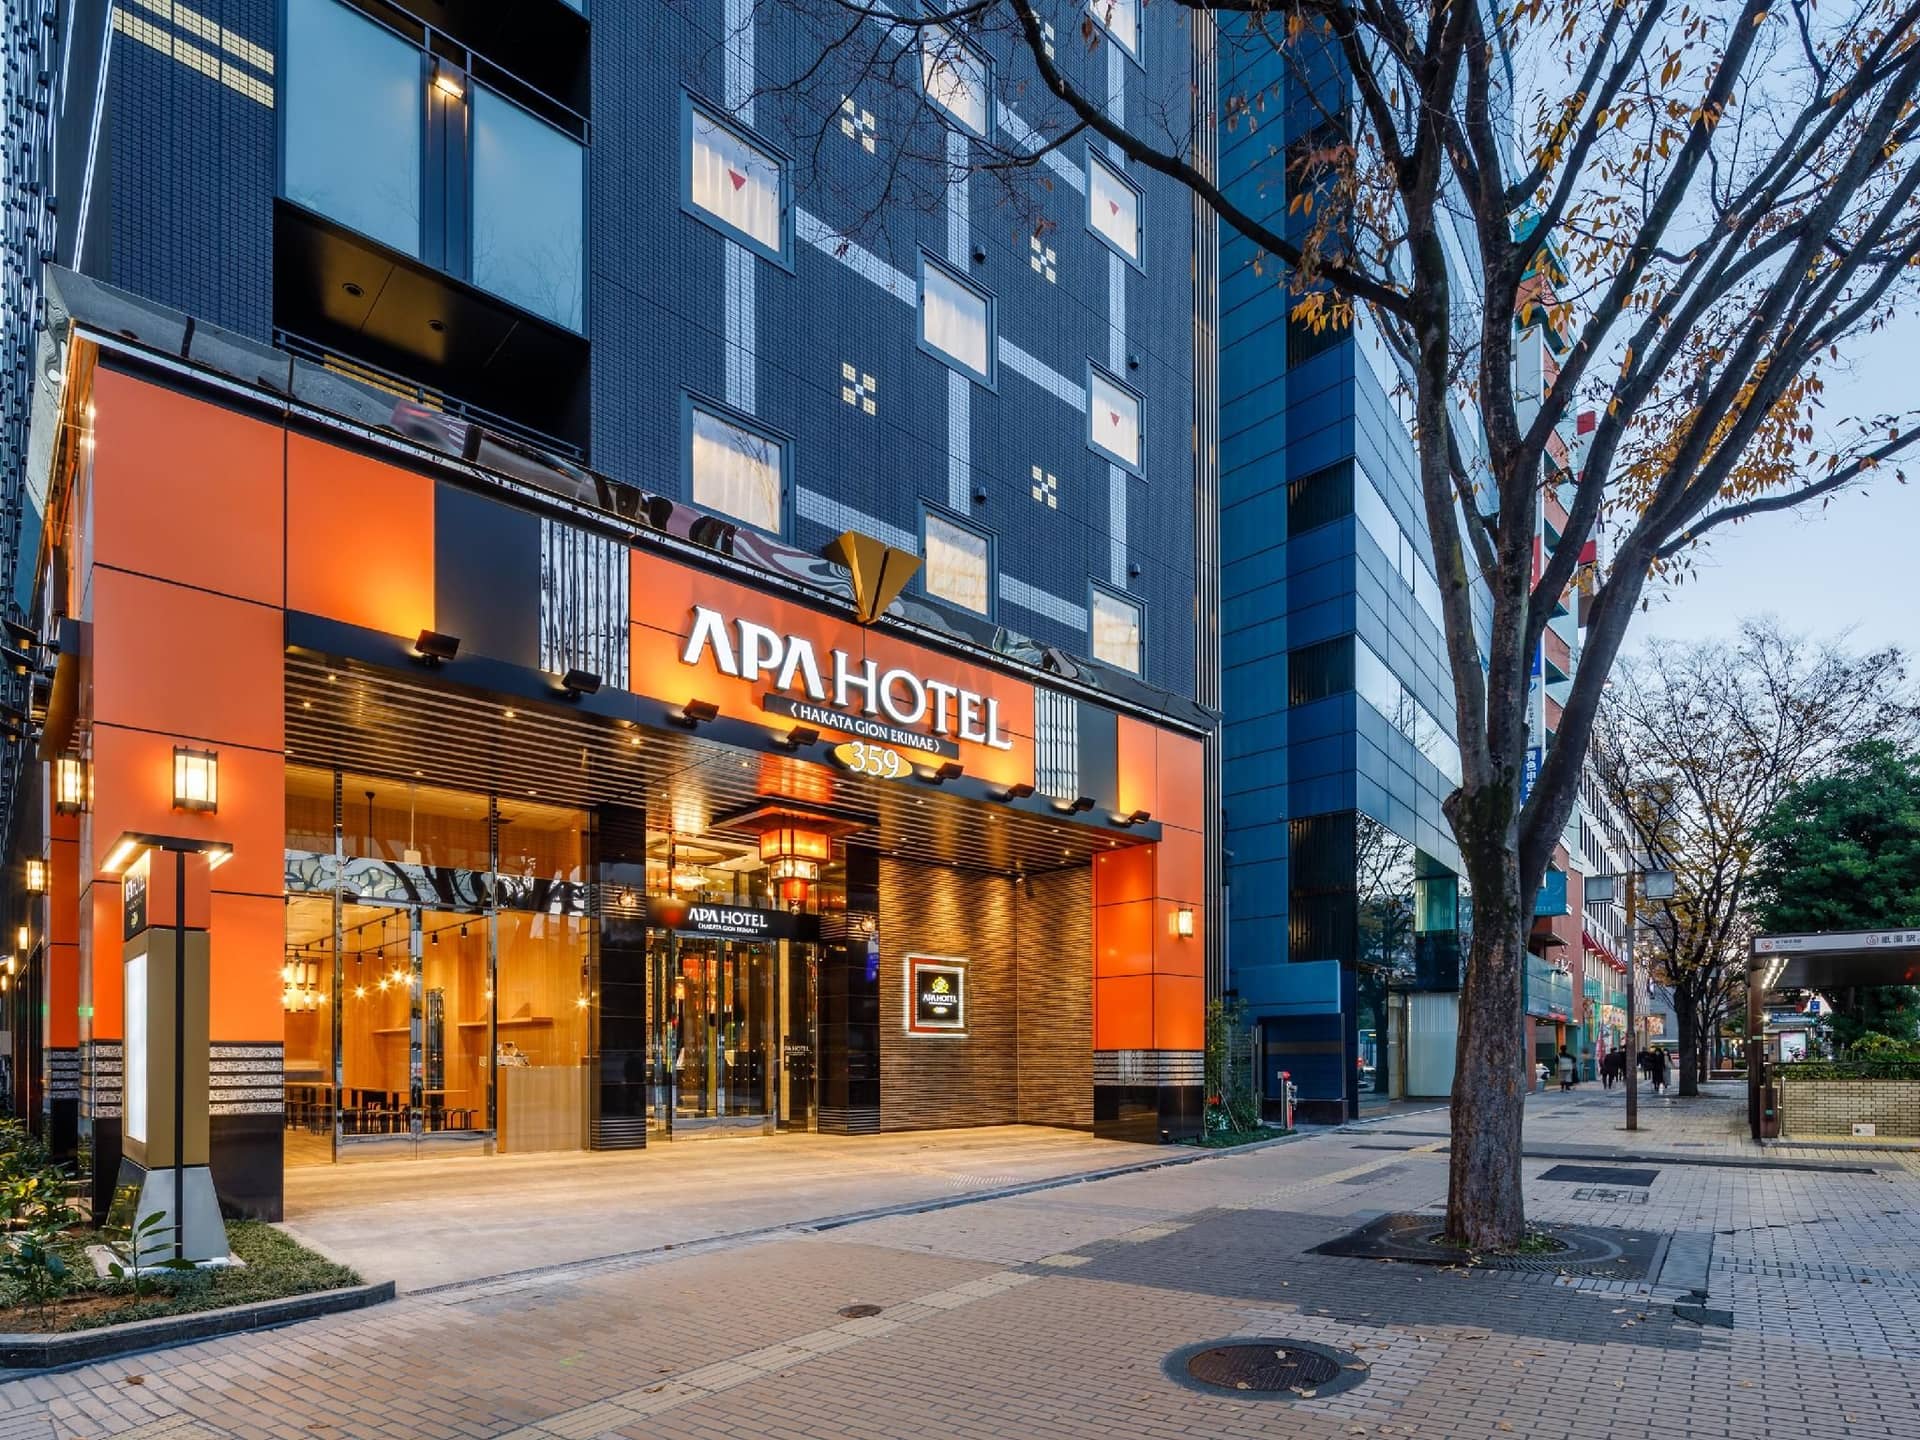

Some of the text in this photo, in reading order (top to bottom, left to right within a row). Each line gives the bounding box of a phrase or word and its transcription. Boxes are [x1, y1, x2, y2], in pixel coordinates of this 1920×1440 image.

[680, 604, 1013, 751] APA HOTEL
[855, 719, 889, 740] GION
[849, 740, 900, 780] 359
[688, 908, 768, 928] APA HOTEL
